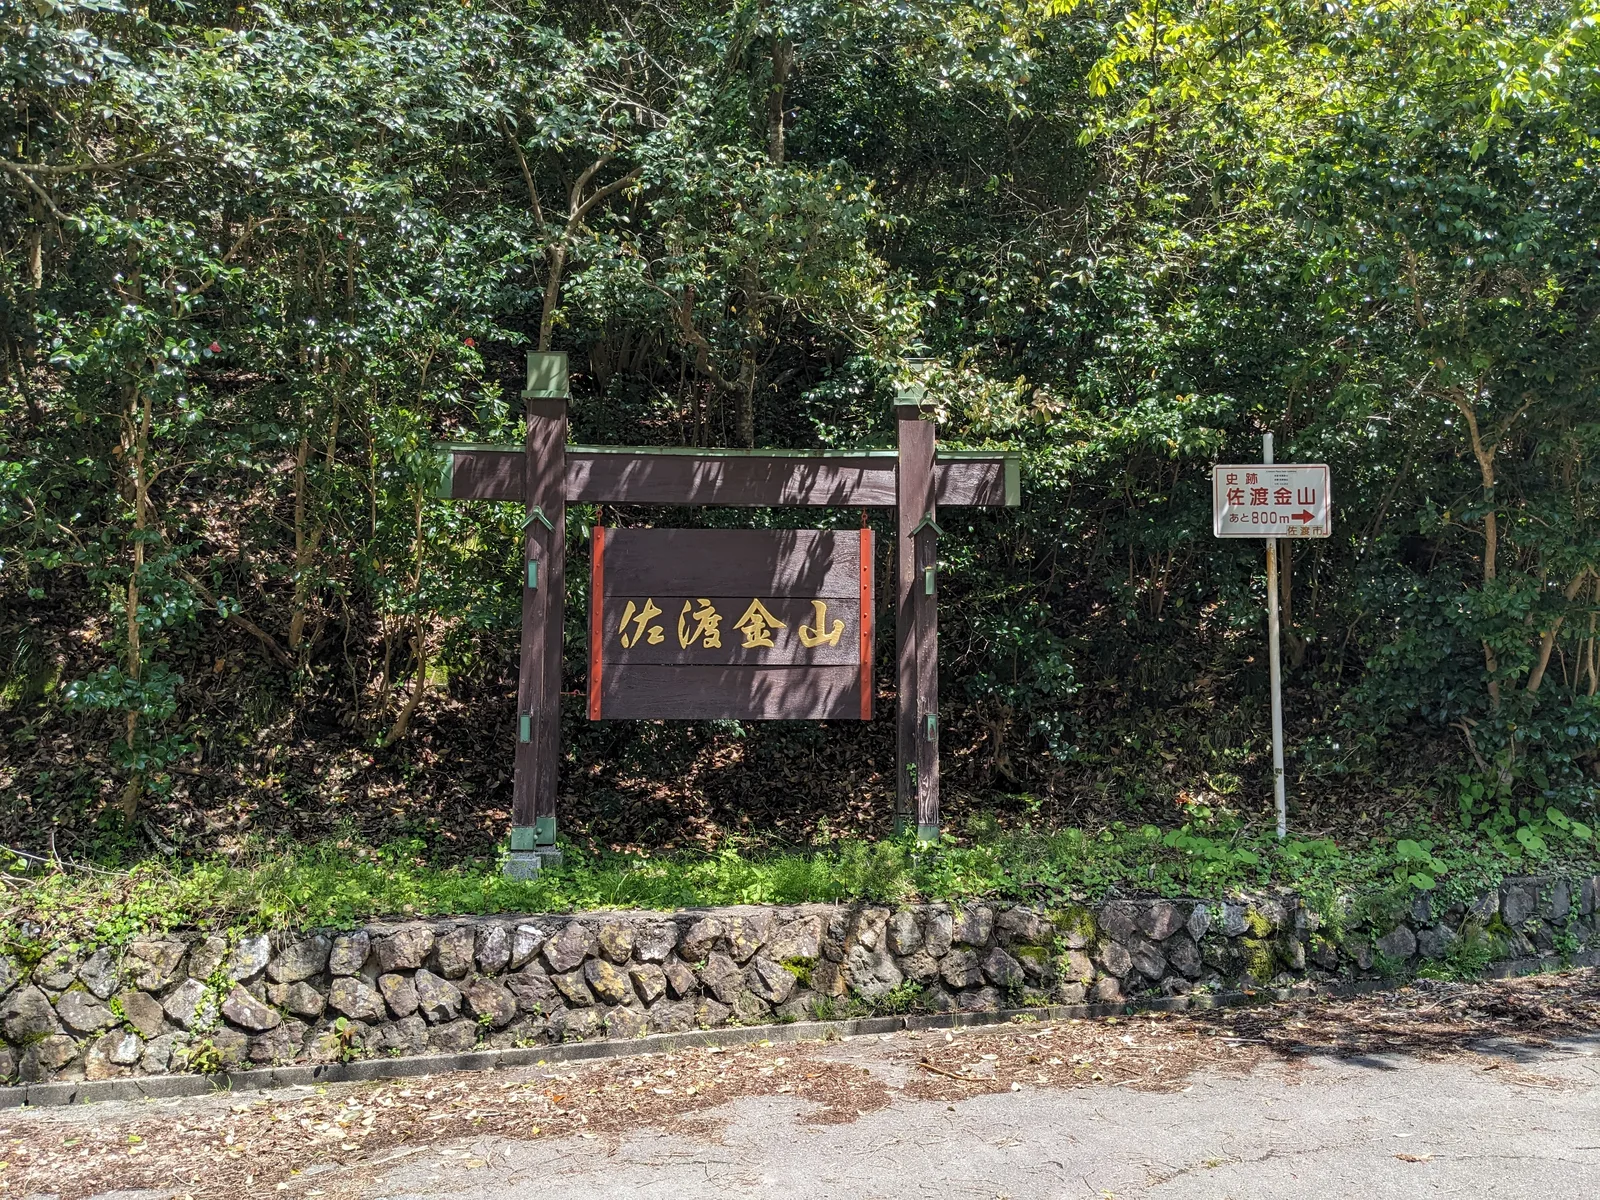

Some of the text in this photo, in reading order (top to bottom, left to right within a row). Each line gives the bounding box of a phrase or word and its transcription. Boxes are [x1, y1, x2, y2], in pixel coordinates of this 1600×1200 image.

[1226, 473, 1258, 485] 史跡
[1226, 487, 1316, 506] 佐渡金山
[1287, 526, 1323, 536] 佐渡市
[618, 597, 846, 649] 佐渡金山
